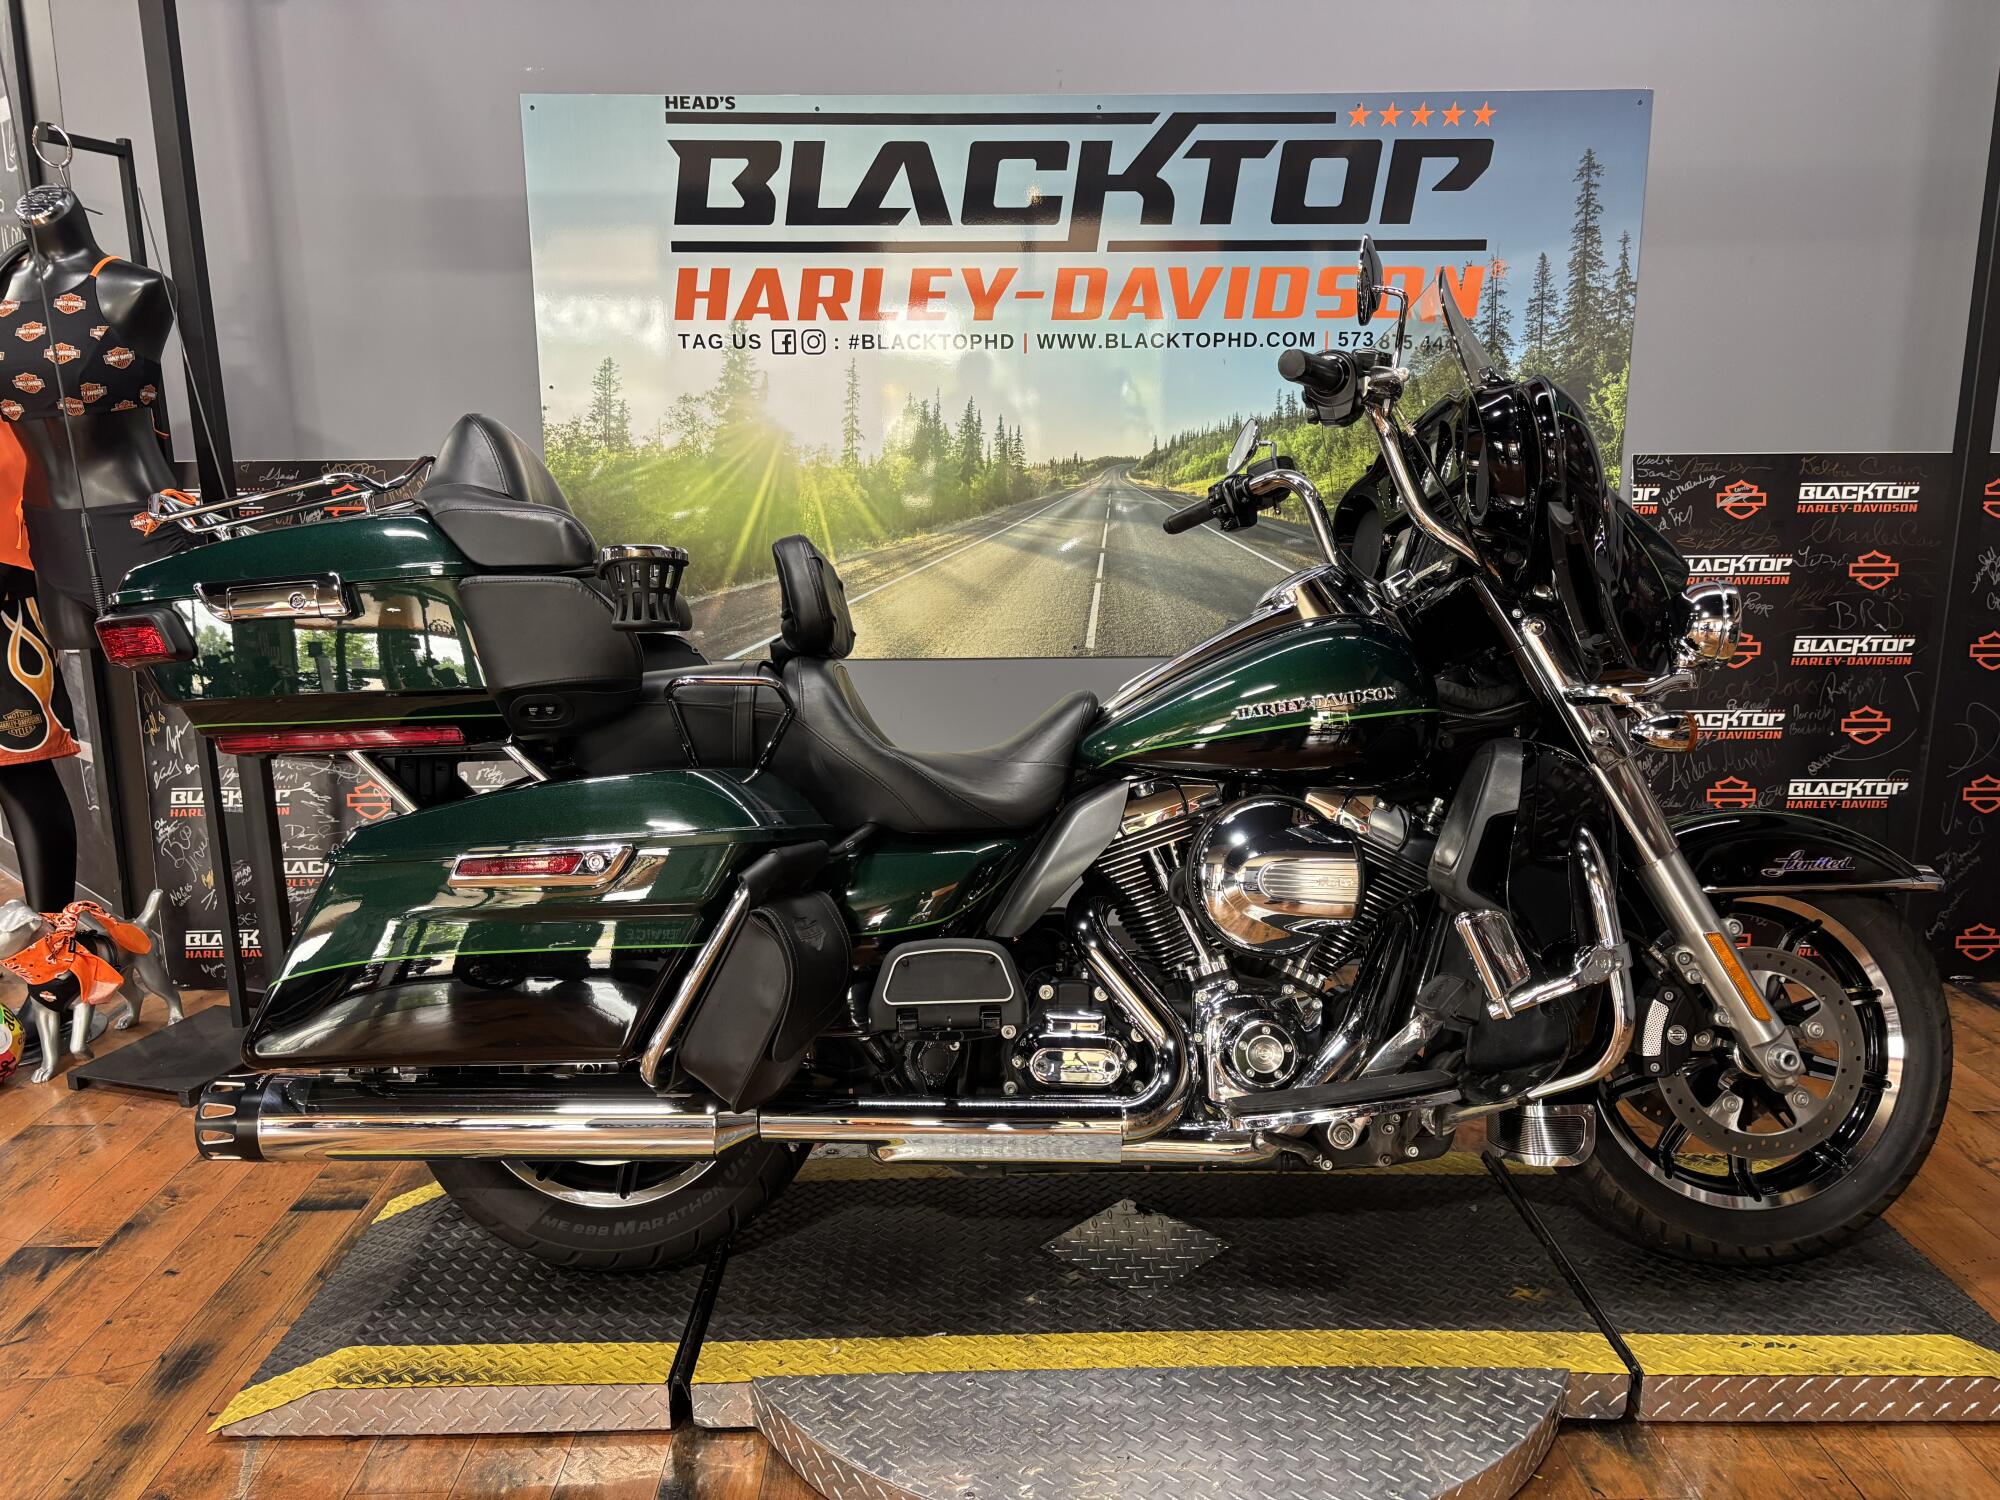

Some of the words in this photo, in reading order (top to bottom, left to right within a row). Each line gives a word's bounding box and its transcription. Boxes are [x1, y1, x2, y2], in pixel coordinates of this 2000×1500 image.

[664, 96, 736, 110] HEAD'S
[667, 136, 1495, 228] BLACKTOP
[678, 333, 723, 350] TAG
[732, 333, 761, 350] US
[848, 333, 1015, 351] #BLACKTOPHD
[1036, 331, 1316, 350] WWW.BLACKTOPHD.COM
[1798, 484, 1921, 501] BLACKTOP
[1796, 503, 1919, 513] HARLEY-DAVIDSON
[1685, 557, 1793, 573] LACKTOP
[1792, 638, 1916, 655] BLACKTOP
[1790, 656, 1913, 667] HARLEY-DAVIDSON
[1693, 713, 1785, 729] ACKTOP
[1697, 730, 1782, 740] EY-DAVIDSON
[1787, 782, 1909, 799] BLACKTOP
[1786, 800, 1888, 809] HARLEY-DAVIDS
[1760, 850, 1856, 878] Limited
[573, 1223, 610, 1236] 888
